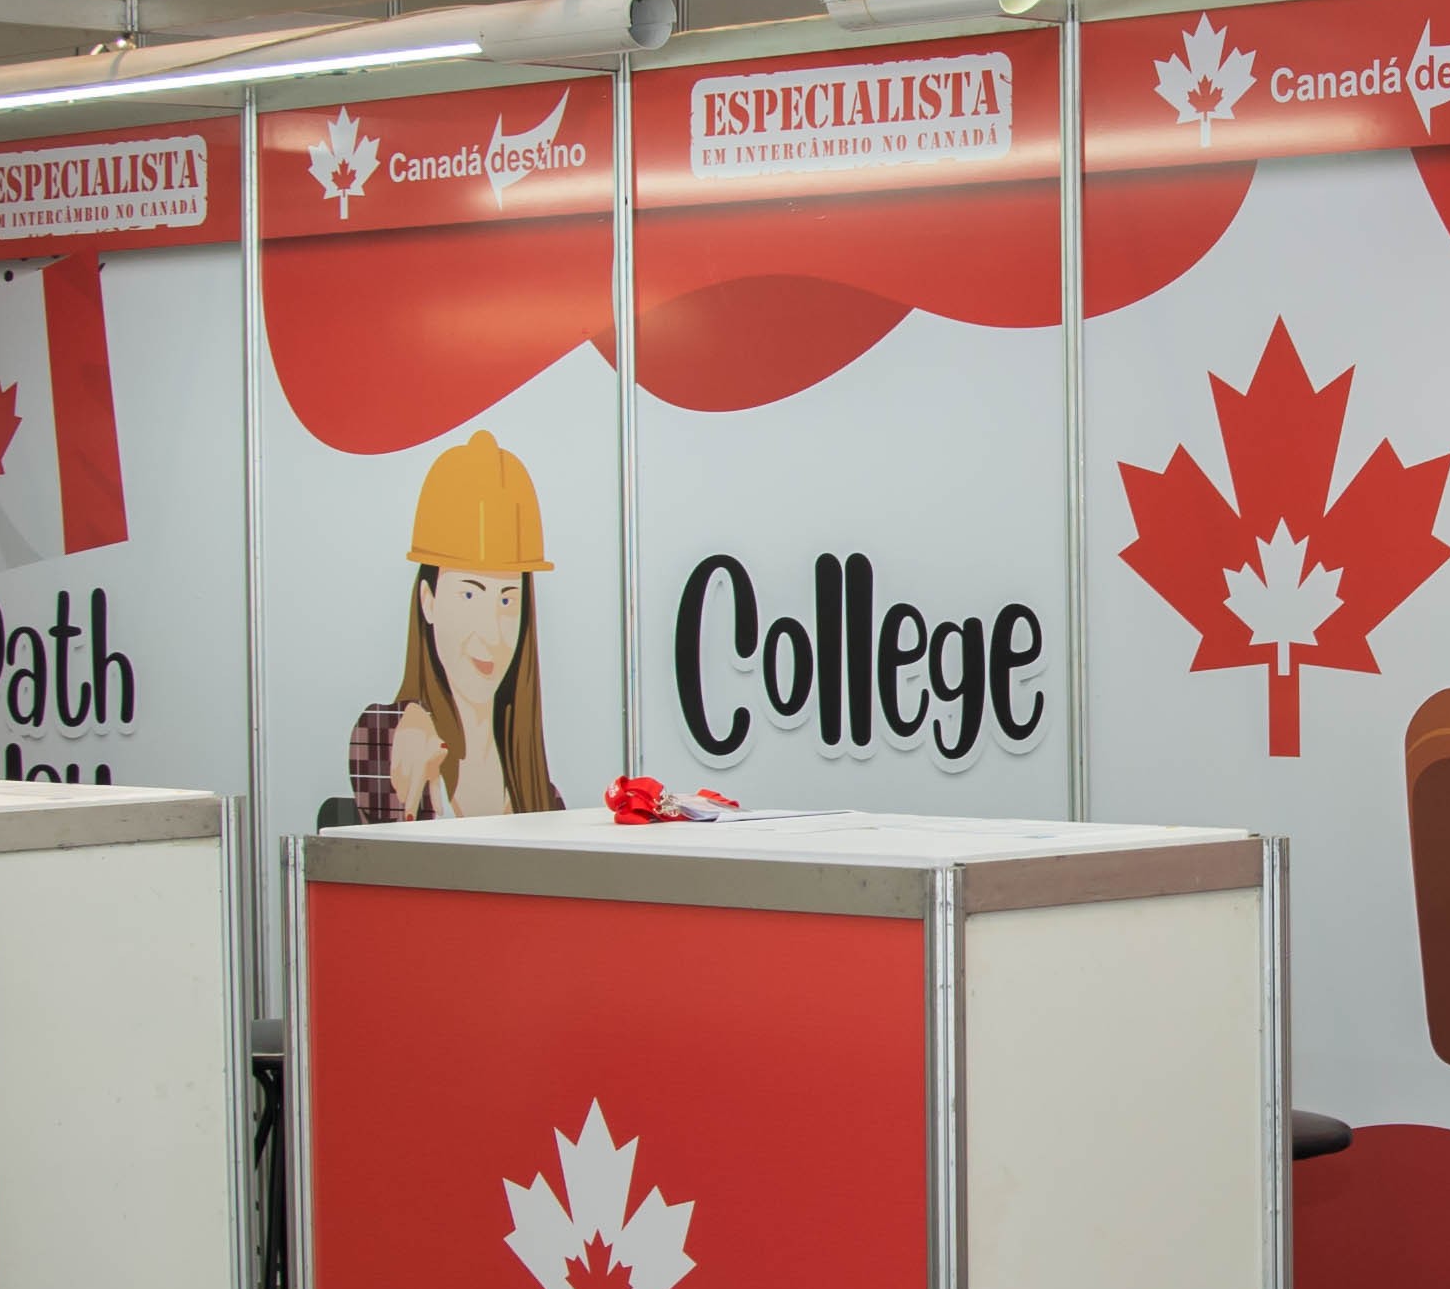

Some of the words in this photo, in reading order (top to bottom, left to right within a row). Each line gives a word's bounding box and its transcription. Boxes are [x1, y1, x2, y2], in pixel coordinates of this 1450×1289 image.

[703, 69, 1000, 136] ESPECIALISTA
[1271, 56, 1403, 104] Canadá
[389, 141, 483, 184] Canadá
[491, 133, 586, 174] destino
[702, 148, 726, 166] EM
[736, 136, 872, 164] INTERCÂMBIO
[882, 134, 907, 152] NO
[917, 123, 998, 150] CANADÁ
[12, 205, 109, 227] INTERCÂMBIO
[116, 204, 134, 219] NO
[141, 196, 198, 217] CANADÁ
[675, 552, 1045, 761] College
